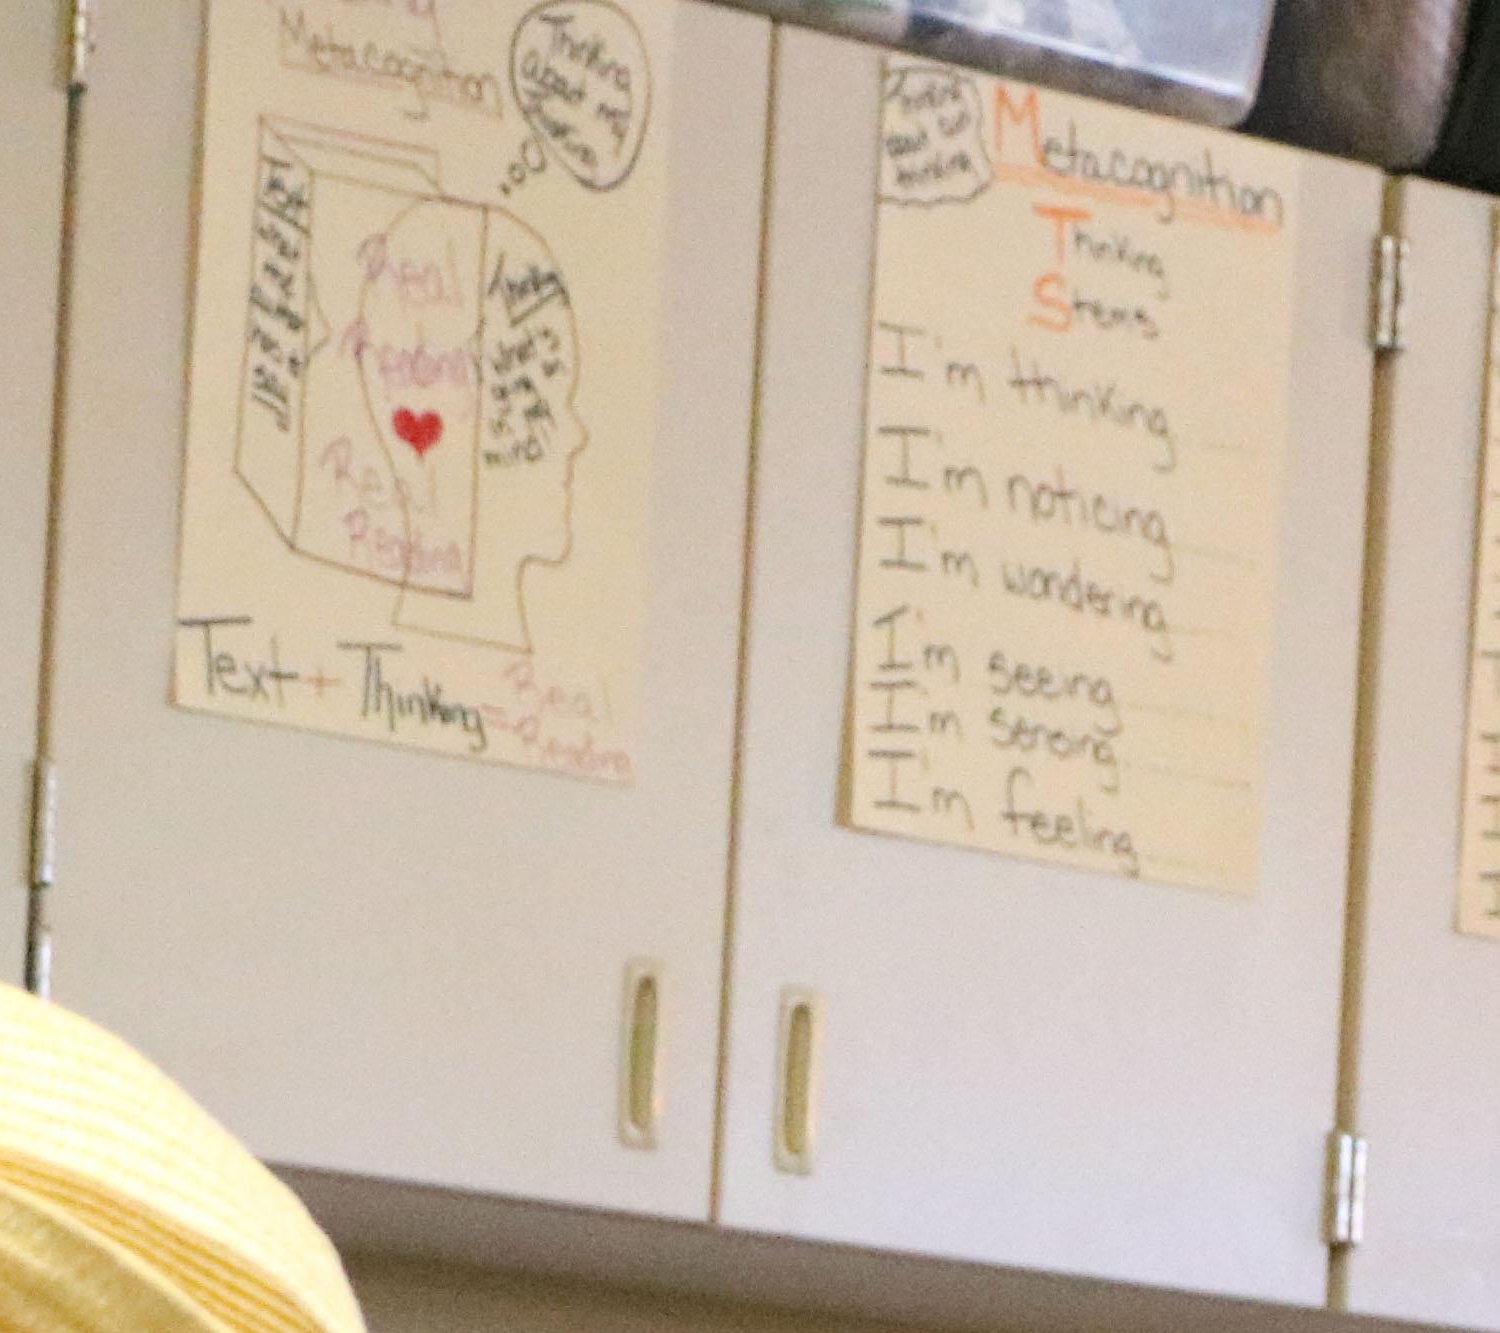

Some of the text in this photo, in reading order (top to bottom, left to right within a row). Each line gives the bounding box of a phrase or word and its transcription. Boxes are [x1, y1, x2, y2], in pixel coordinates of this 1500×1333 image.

[993, 84, 1286, 230] Metacognition
[1033, 206, 1170, 301] Thinking
[876, 320, 1177, 472] I'm thinking
[875, 516, 980, 588] I'm
[876, 423, 1177, 585] I'm noticing
[177, 614, 300, 708] Text
[870, 604, 961, 682] I'm
[866, 746, 1140, 879] I'm feeling
